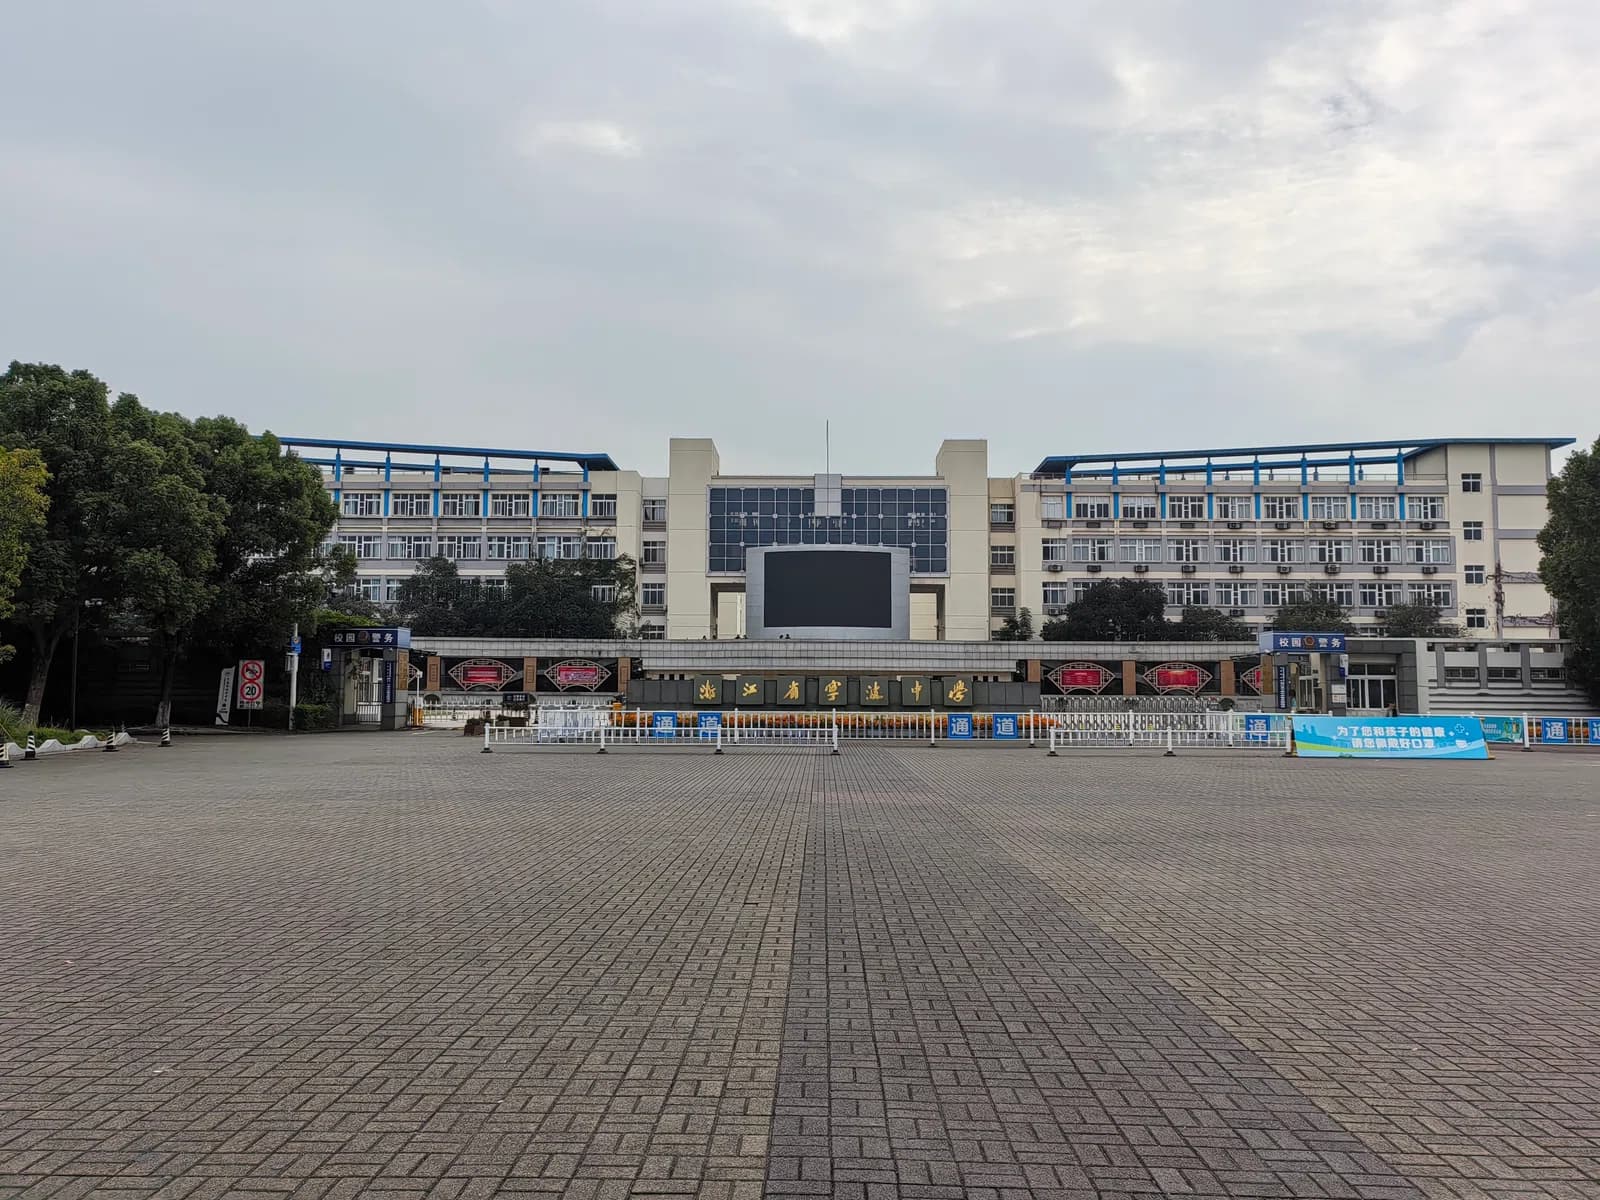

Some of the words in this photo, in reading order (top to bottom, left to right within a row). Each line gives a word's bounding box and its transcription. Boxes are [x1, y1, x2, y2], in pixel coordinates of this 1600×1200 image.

[333, 632, 394, 644] 校园警务
[1279, 637, 1342, 648] 校园警务
[245, 686, 257, 696] 20
[1336, 726, 1445, 737] 为了您和孩子的健康
